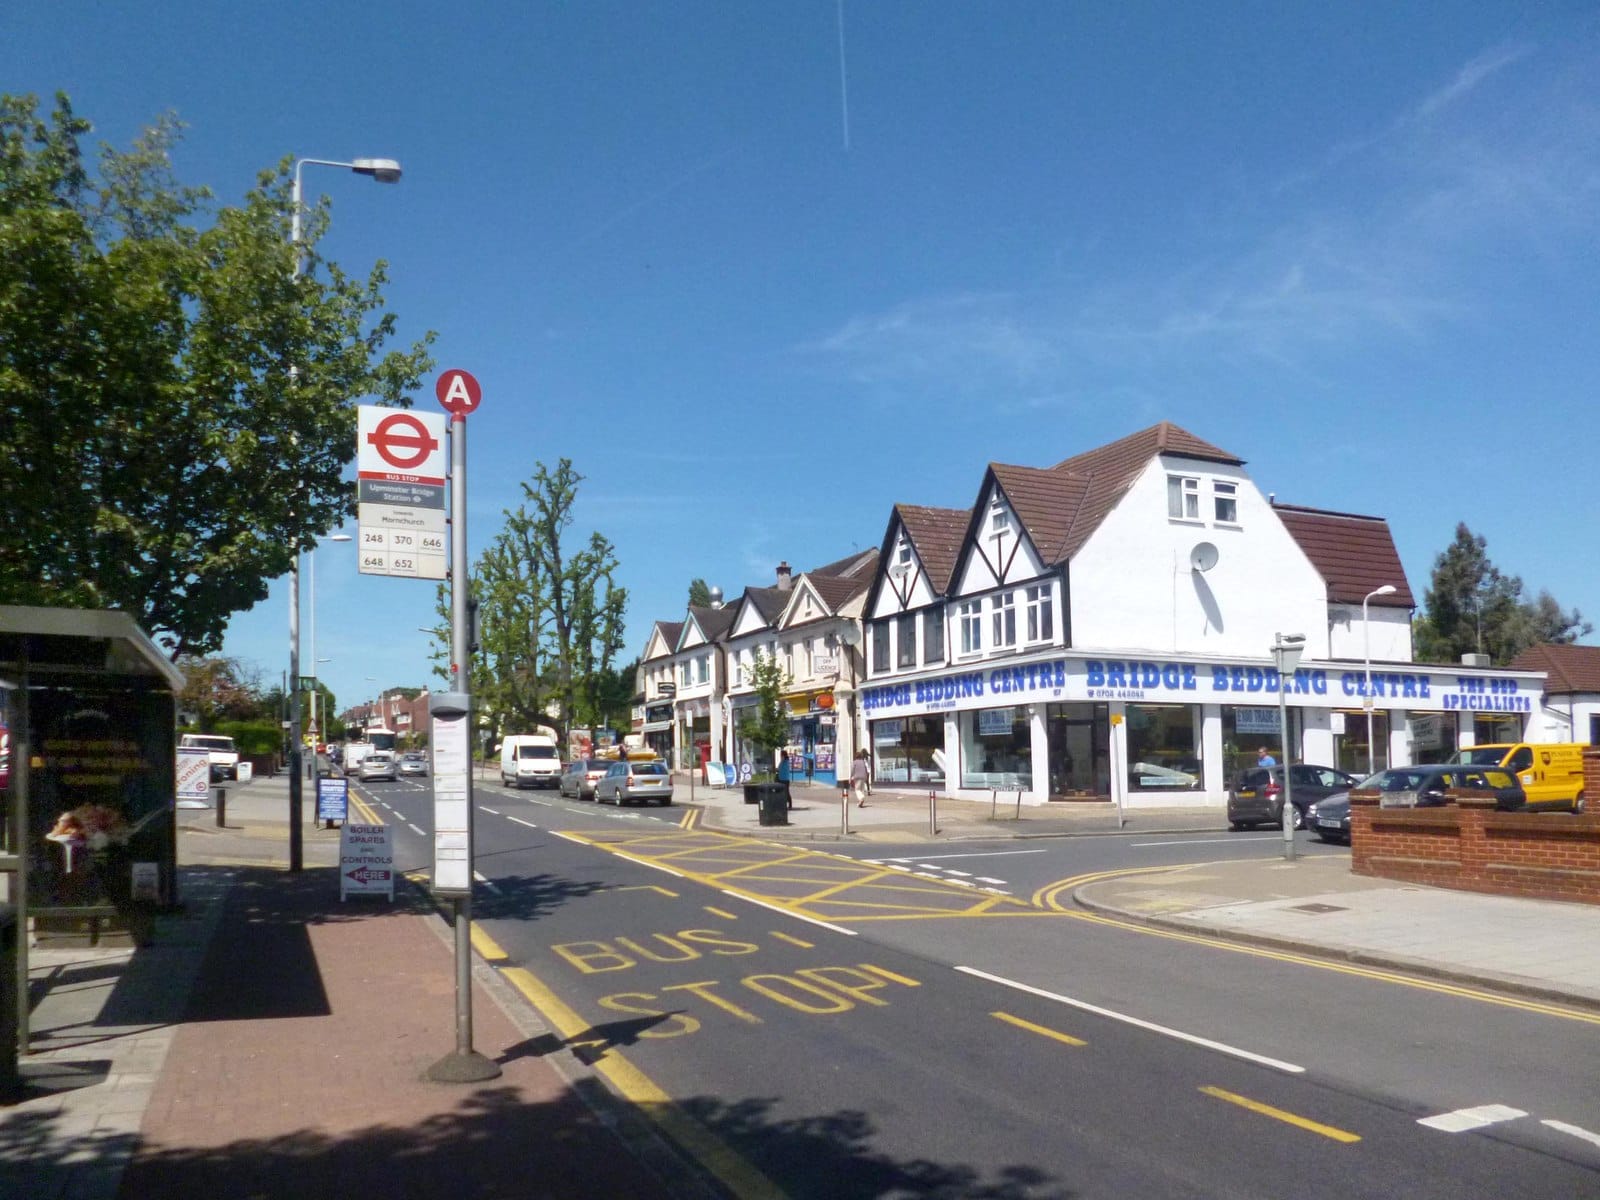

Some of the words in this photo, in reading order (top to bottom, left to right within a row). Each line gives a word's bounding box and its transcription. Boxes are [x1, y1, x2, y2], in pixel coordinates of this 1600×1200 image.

[445, 375, 472, 406] A
[369, 484, 409, 494] Upminster
[412, 488, 435, 497] Bridge
[384, 493, 411, 502] Station
[382, 516, 424, 525] Hornchurch
[365, 534, 383, 543] 248
[395, 536, 413, 545] 370
[423, 538, 442, 548] 646
[364, 557, 383, 566] 648
[394, 559, 413, 569] 652
[863, 684, 911, 710] BRIDGE
[915, 672, 984, 704] BEDDING
[990, 660, 1065, 694] CENTRE
[1086, 661, 1196, 690] BRIDGE
[1341, 672, 1430, 699] CENTRE
[1457, 677, 1484, 693] THE
[1490, 679, 1517, 695] BED
[1442, 694, 1530, 711] SPECIALISTS
[354, 872, 385, 880] HERE
[551, 929, 759, 974] BUS
[599, 966, 890, 1038] STOP
